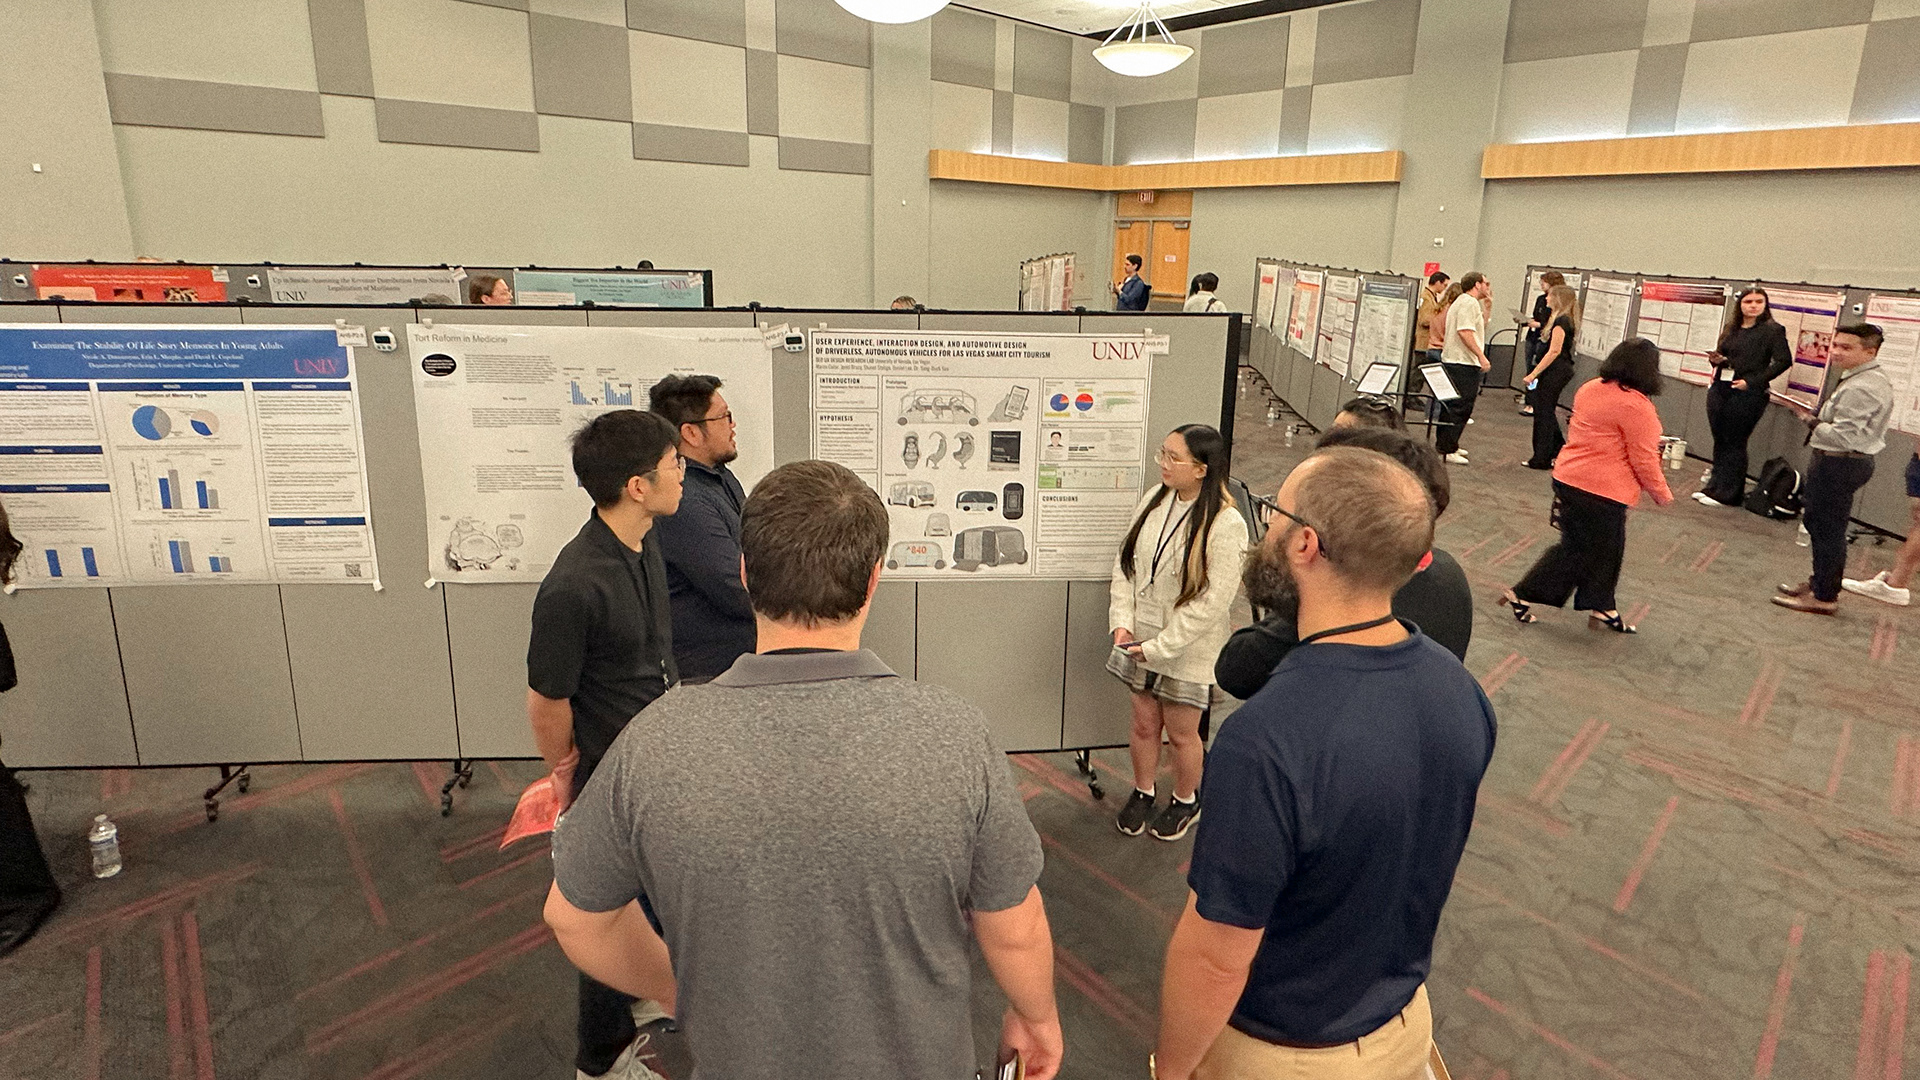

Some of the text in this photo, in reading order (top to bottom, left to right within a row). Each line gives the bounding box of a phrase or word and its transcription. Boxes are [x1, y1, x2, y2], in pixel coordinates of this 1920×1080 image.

[414, 334, 430, 342] Tort
[432, 334, 462, 343] Reform
[472, 335, 508, 344] Medicine
[815, 338, 832, 346] USER
[834, 339, 875, 347] EXPERIENCE,
[877, 339, 918, 347] INTERACTION
[920, 340, 946, 348] DESIGN,
[962, 341, 1002, 349] AUTOMOTIVE
[32, 341, 284, 351] Examining The Stability Of Life Story Memories In Young Adults
[1092, 341, 1145, 360] UNLV
[824, 348, 864, 356] DRIVERLESS,
[865, 348, 907, 356] AUTONOMOUS
[965, 350, 986, 358] VEGAS
[294, 358, 339, 375] UNLV
